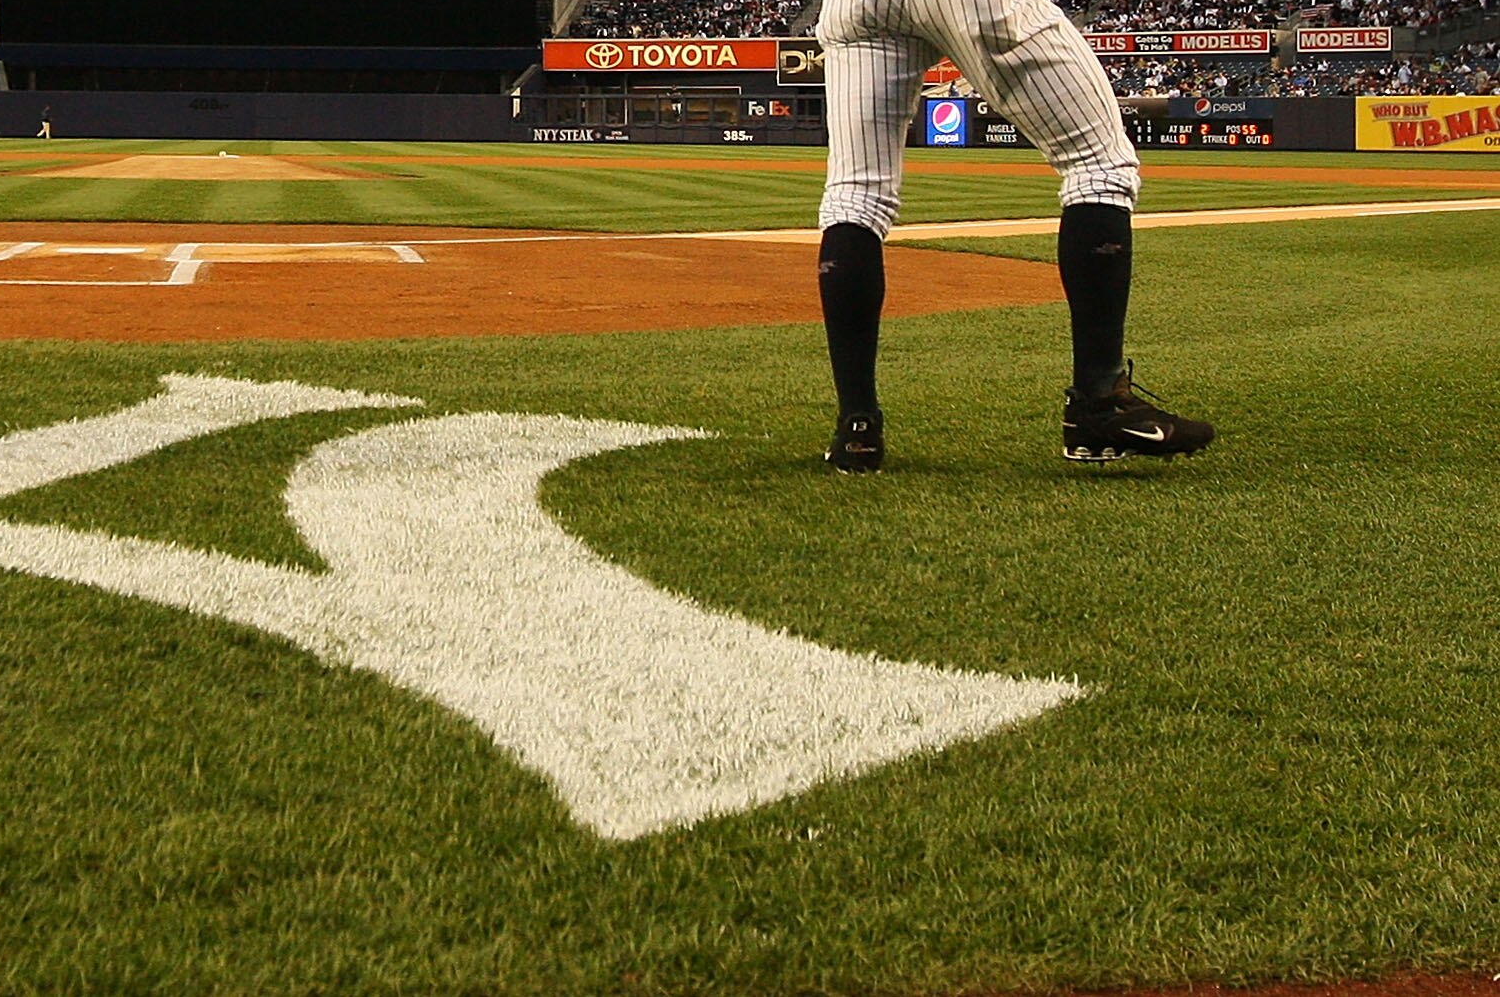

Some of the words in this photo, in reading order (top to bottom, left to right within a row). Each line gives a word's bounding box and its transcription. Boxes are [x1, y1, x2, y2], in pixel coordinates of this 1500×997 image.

[1089, 37, 1126, 50] ELL'S
[1181, 33, 1262, 49] MODELL'S
[1301, 31, 1388, 47] MODELL'S
[627, 45, 737, 67] TOYOTA
[1213, 102, 1246, 114] pepsi
[1372, 104, 1401, 118] WHO
[1404, 104, 1429, 116] BUT
[987, 124, 1015, 133] ANGELS
[533, 129, 559, 141] NYY
[559, 129, 595, 142] STEAK
[985, 134, 1017, 143] YANKEES
[1160, 135, 1178, 143] BALL
[1202, 135, 1227, 144] STRIKE
[852, 421, 868, 432] 13
